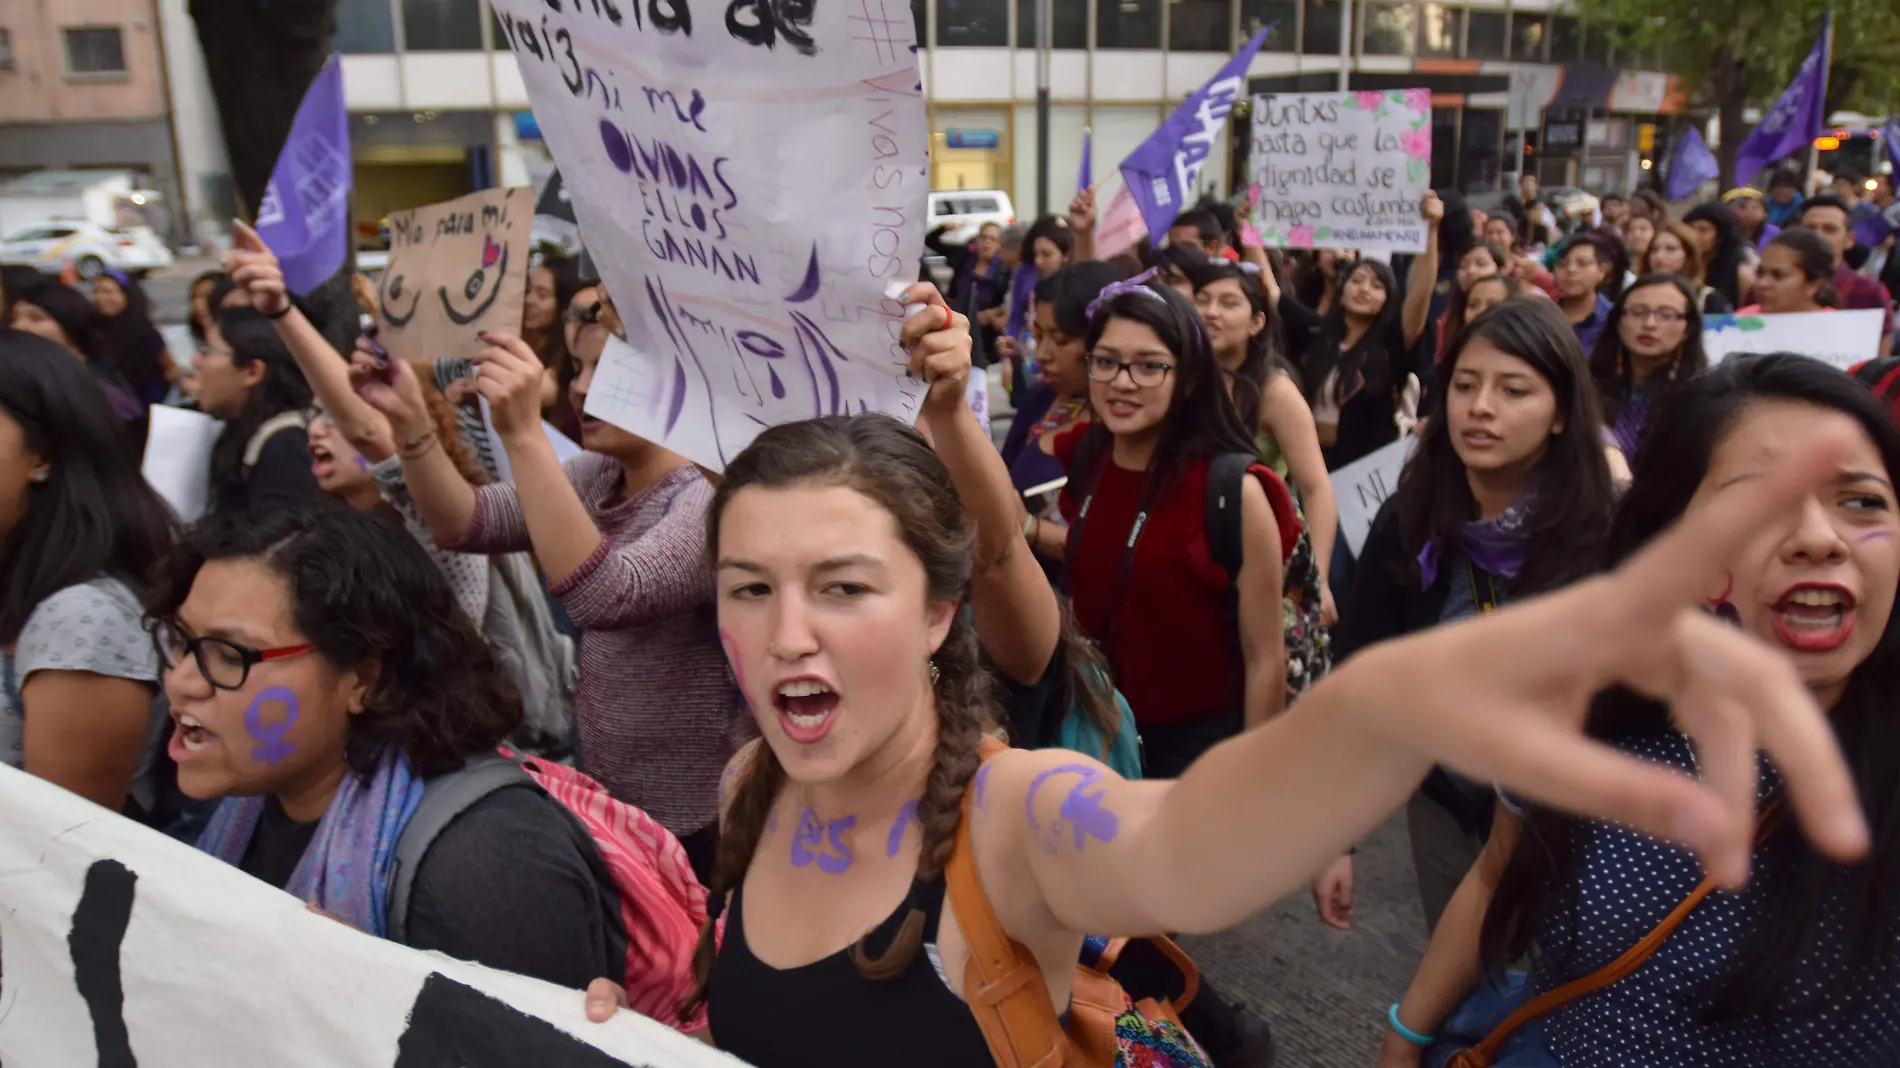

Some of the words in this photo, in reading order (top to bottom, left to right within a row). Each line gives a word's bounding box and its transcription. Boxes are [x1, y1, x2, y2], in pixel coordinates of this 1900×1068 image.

[641, 86, 708, 132] me
[1318, 132, 1359, 164] que
[1373, 128, 1400, 152] la
[1256, 156, 1358, 195] dignidad
[1367, 166, 1396, 188] se
[638, 181, 727, 240] ELLOS
[642, 219, 761, 285] GANAN
[867, 205, 906, 279] nos
